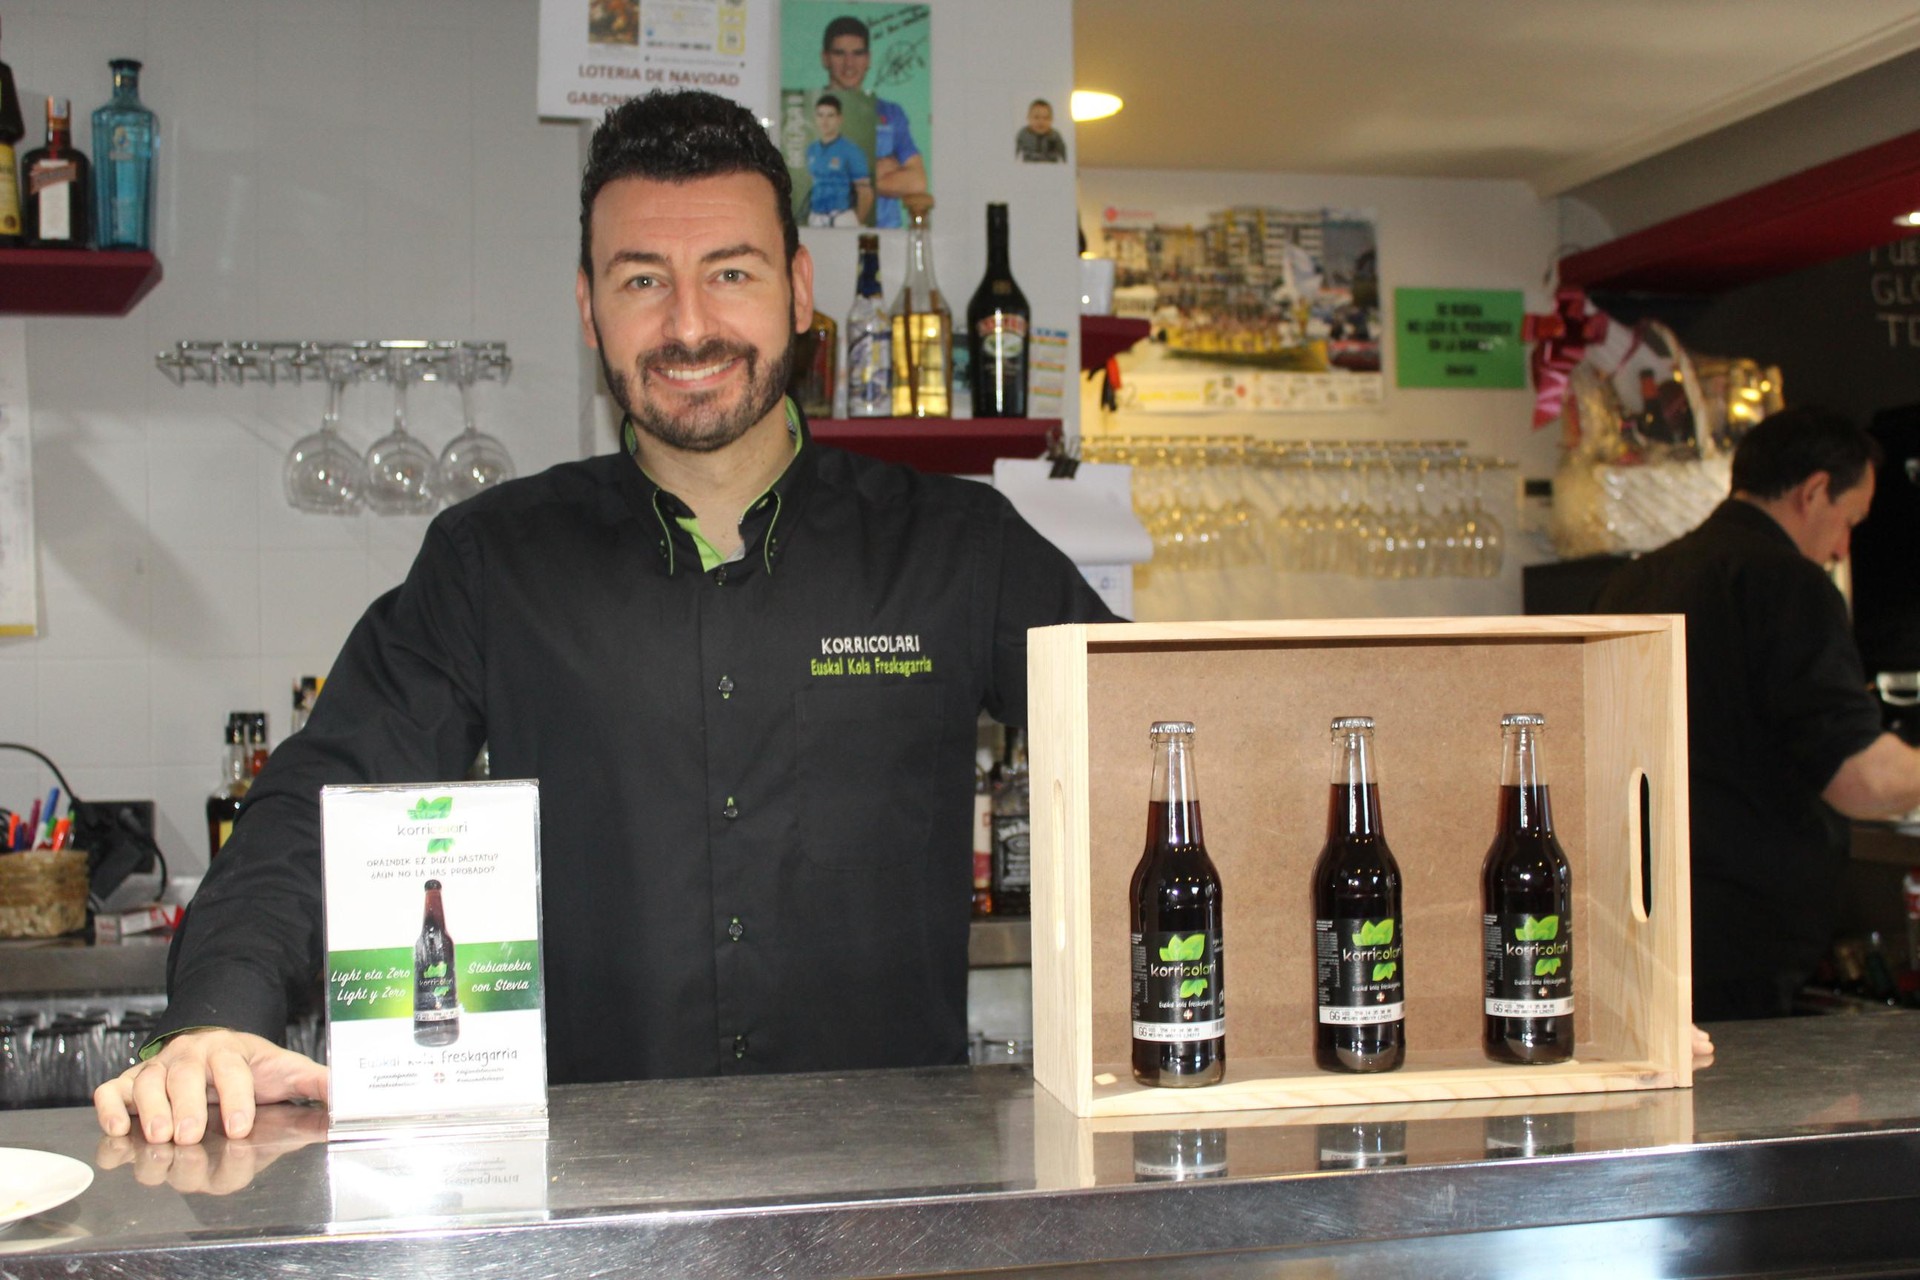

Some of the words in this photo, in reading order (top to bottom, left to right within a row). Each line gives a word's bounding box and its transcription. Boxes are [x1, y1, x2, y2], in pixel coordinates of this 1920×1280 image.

[578, 64, 641, 80] LOTERIA
[645, 68, 664, 82] DE
[669, 70, 739, 86] NAVIDAD
[821, 635, 920, 654] KORRICOLARI
[811, 657, 843, 675] Euskal
[848, 656, 871, 675] Kola
[874, 655, 932, 678] Freskagarria
[367, 857, 411, 867] ORAINDIK
[415, 857, 425, 866] EZ
[431, 855, 454, 864] DUZU
[459, 854, 498, 863] DASTATU?
[398, 869, 411, 878] NO
[415, 868, 425, 877] LA
[430, 867, 446, 876] HAS
[451, 866, 495, 875] PROBADO?
[1506, 941, 1568, 957] korricolari
[467, 960, 532, 975] Stebiarekin
[1151, 960, 1216, 977] korricolari
[331, 968, 361, 987] Light
[364, 970, 382, 980] eta
[386, 967, 411, 979] Zero
[471, 983, 490, 993] con
[494, 980, 529, 992] Stevia
[337, 987, 367, 1006] Light
[370, 991, 378, 1003] y
[382, 986, 407, 998] Zero
